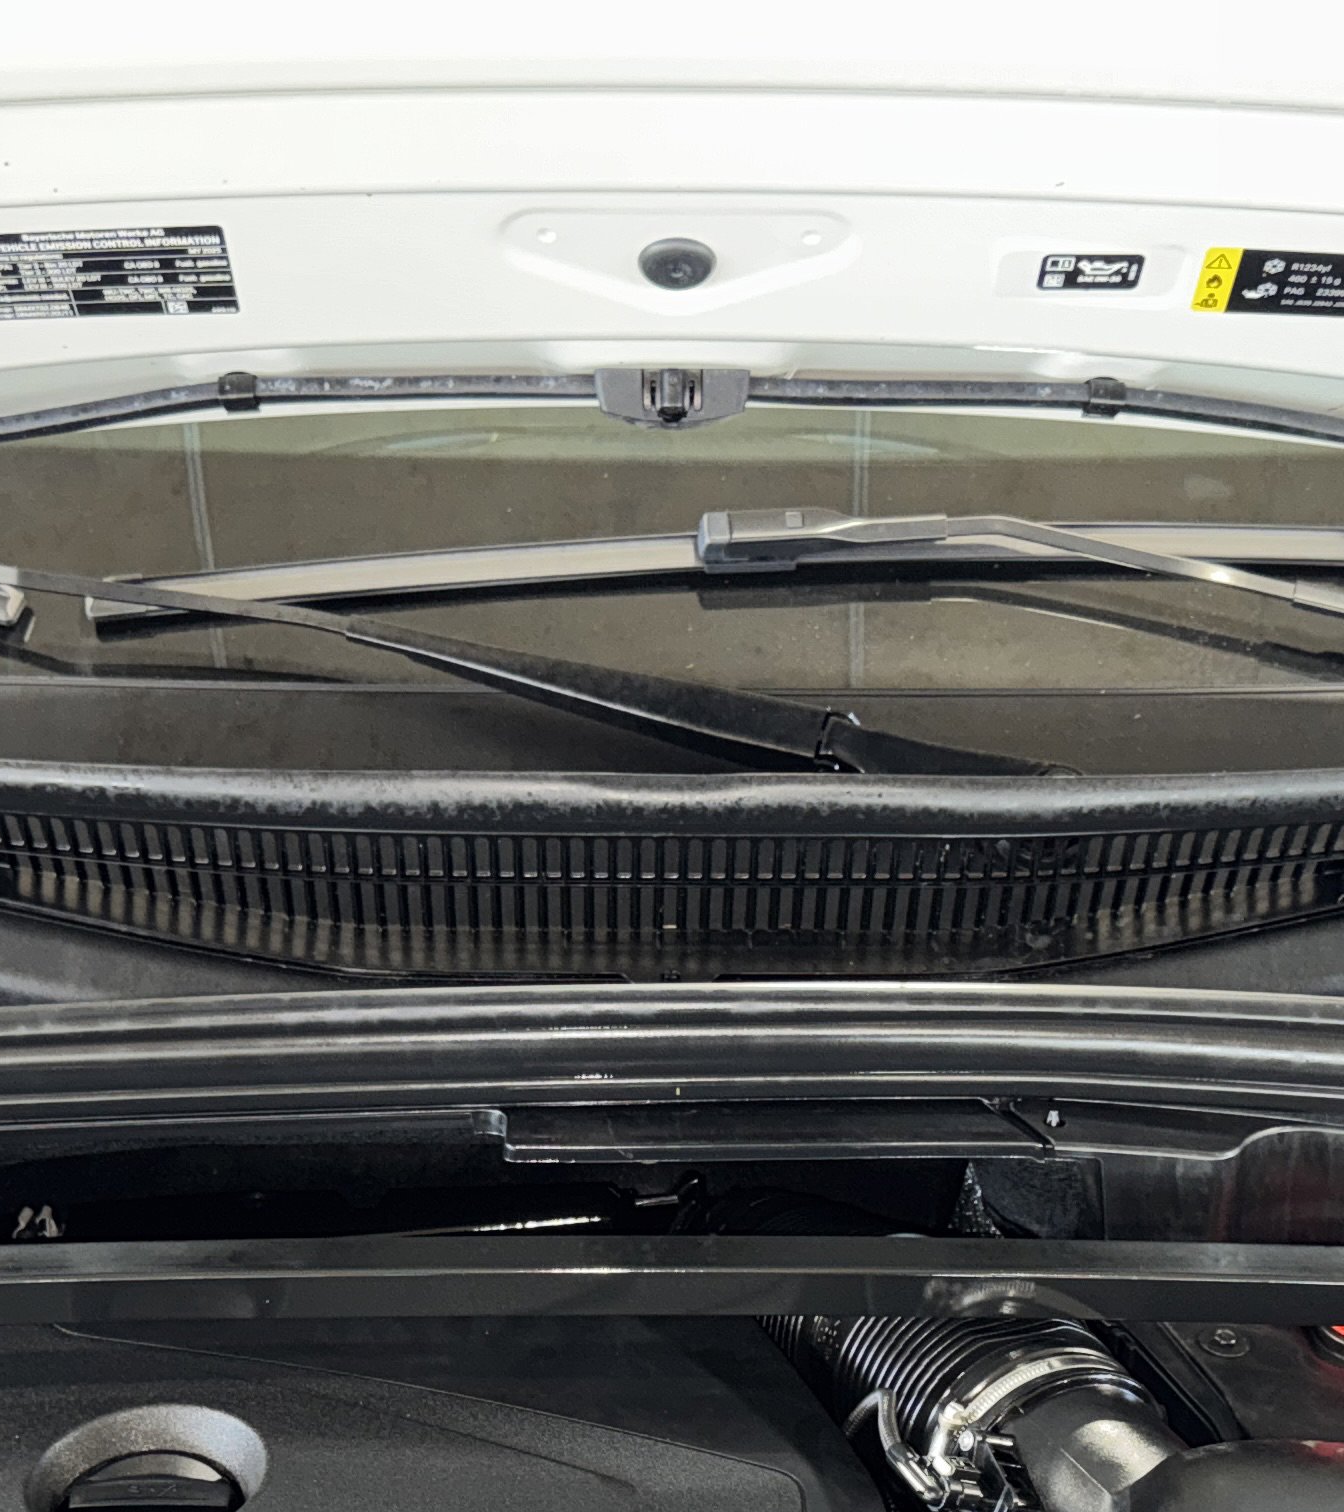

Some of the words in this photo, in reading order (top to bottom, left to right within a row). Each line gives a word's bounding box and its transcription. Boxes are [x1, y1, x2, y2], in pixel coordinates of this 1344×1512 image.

[150, 228, 165, 236] AG
[39, 241, 92, 250] EMISSION
[92, 239, 144, 248] CONTROL
[144, 235, 220, 247] INFORMATION
[1291, 262, 1333, 273] R1234yf
